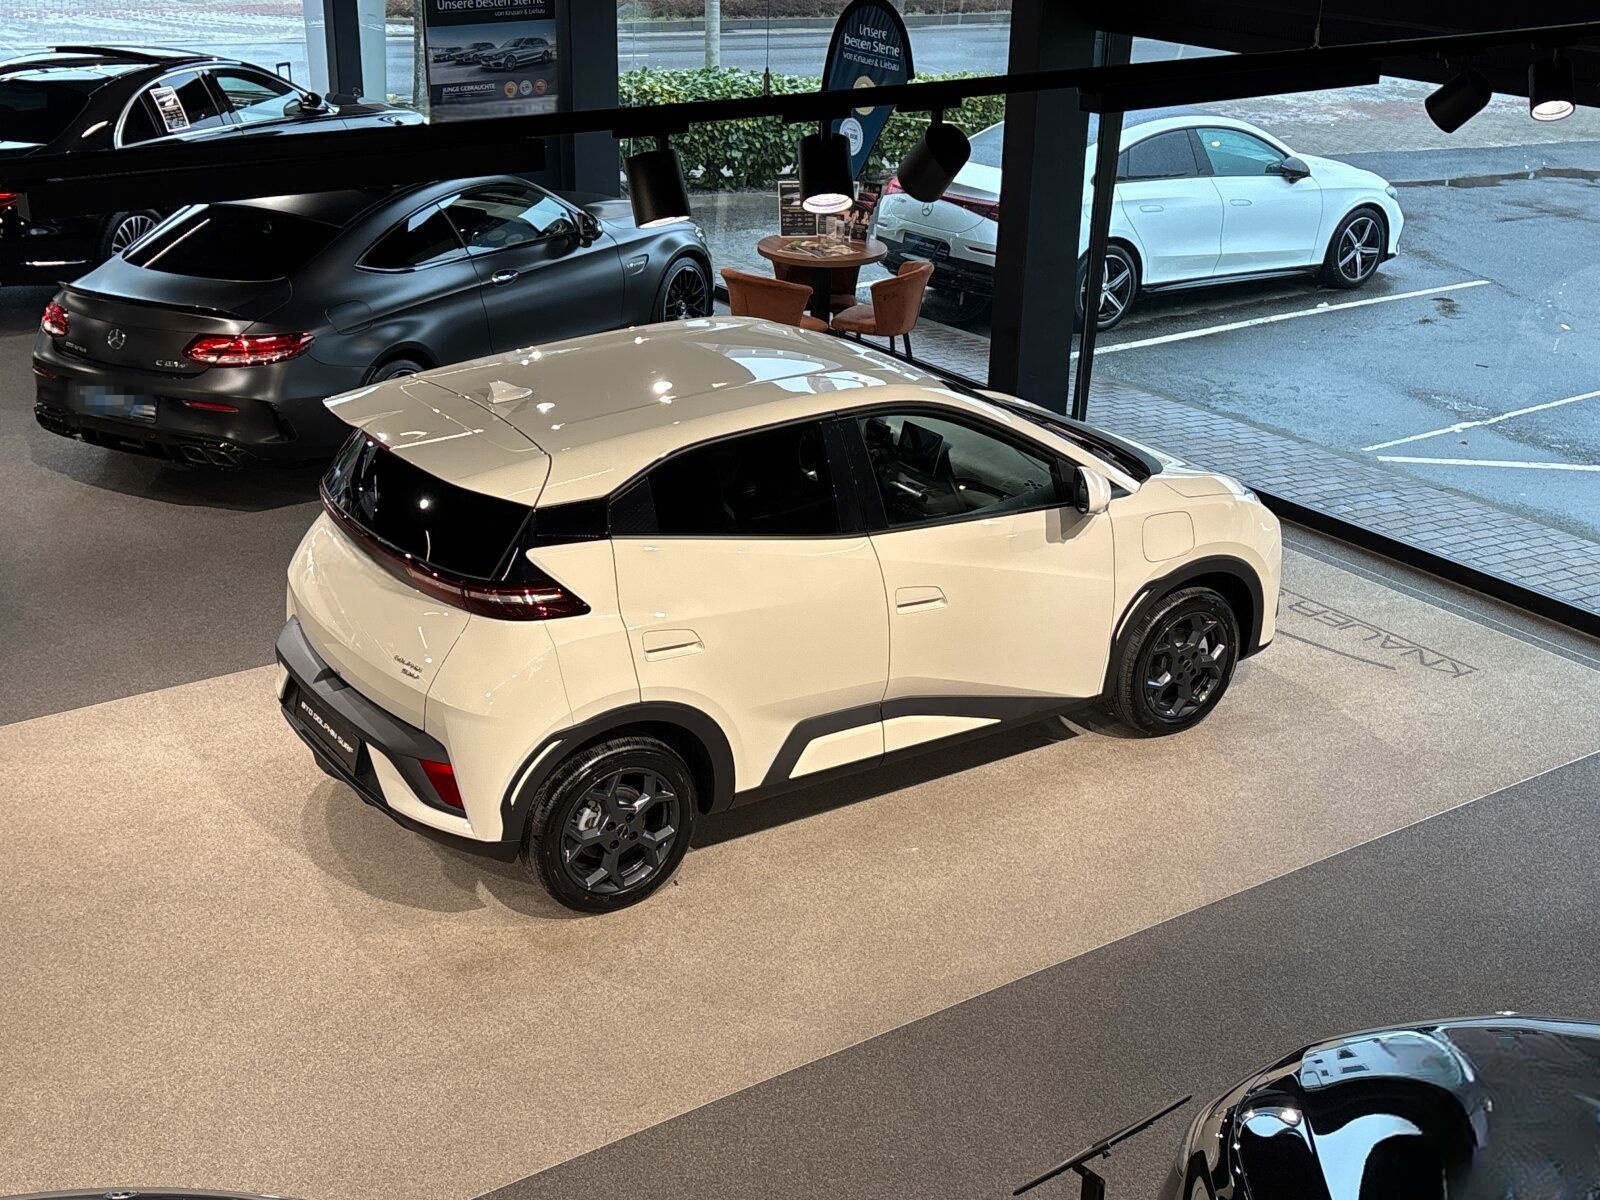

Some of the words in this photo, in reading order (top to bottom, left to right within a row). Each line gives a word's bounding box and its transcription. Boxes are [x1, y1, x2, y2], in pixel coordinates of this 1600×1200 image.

[437, 0, 474, 10] Unsere
[859, 23, 888, 40] Unsere
[844, 32, 872, 52] besten
[872, 40, 900, 57] Sterne
[1287, 600, 1474, 679] KNAUER
